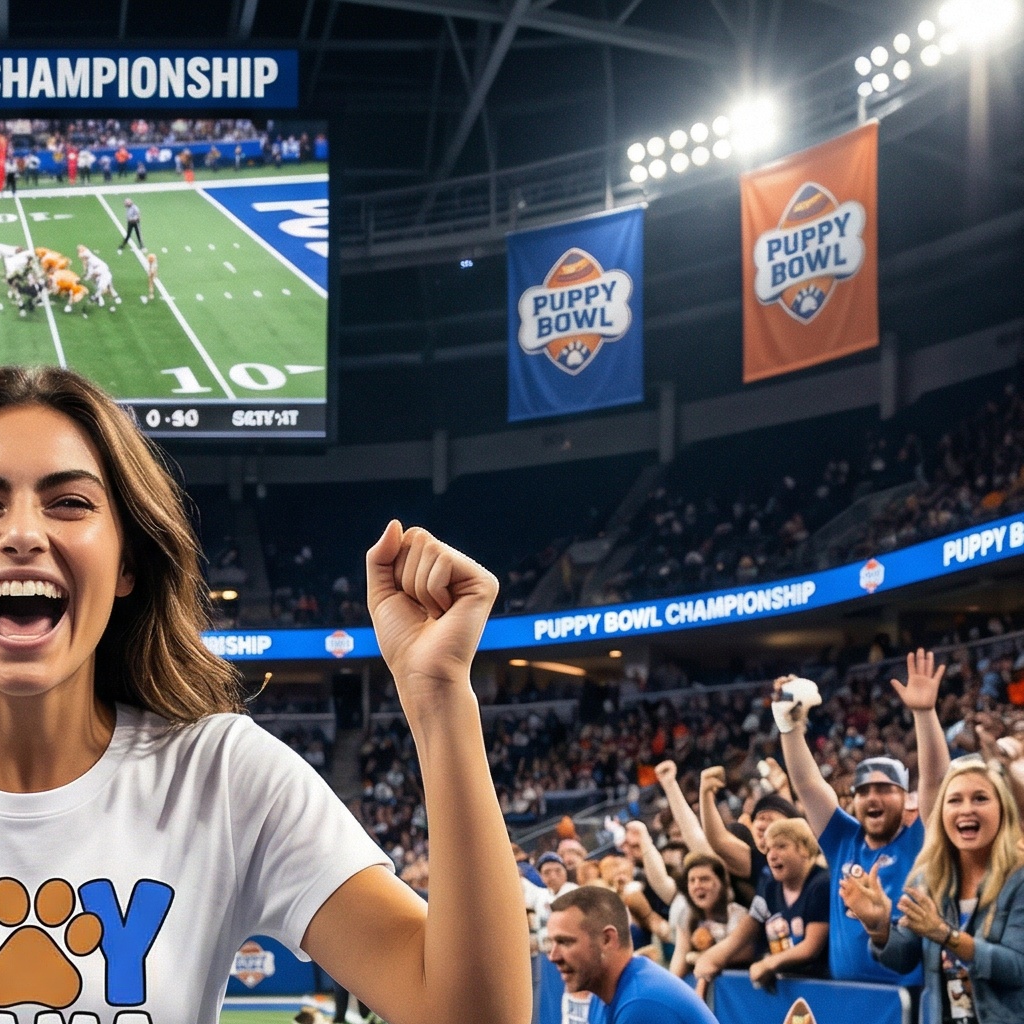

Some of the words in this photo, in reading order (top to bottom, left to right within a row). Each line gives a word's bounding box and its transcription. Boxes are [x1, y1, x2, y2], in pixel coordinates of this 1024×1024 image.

[767, 212, 851, 262] PUPPY
[771, 243, 847, 288] BOWL
[533, 280, 617, 316] PUPPY
[537, 306, 613, 339] BOWL
[943, 525, 1007, 567] PUPPY
[534, 613, 601, 640] PUPPY
[604, 606, 662, 634] BOWL
[665, 580, 816, 626] CHAMPIONSHIP
